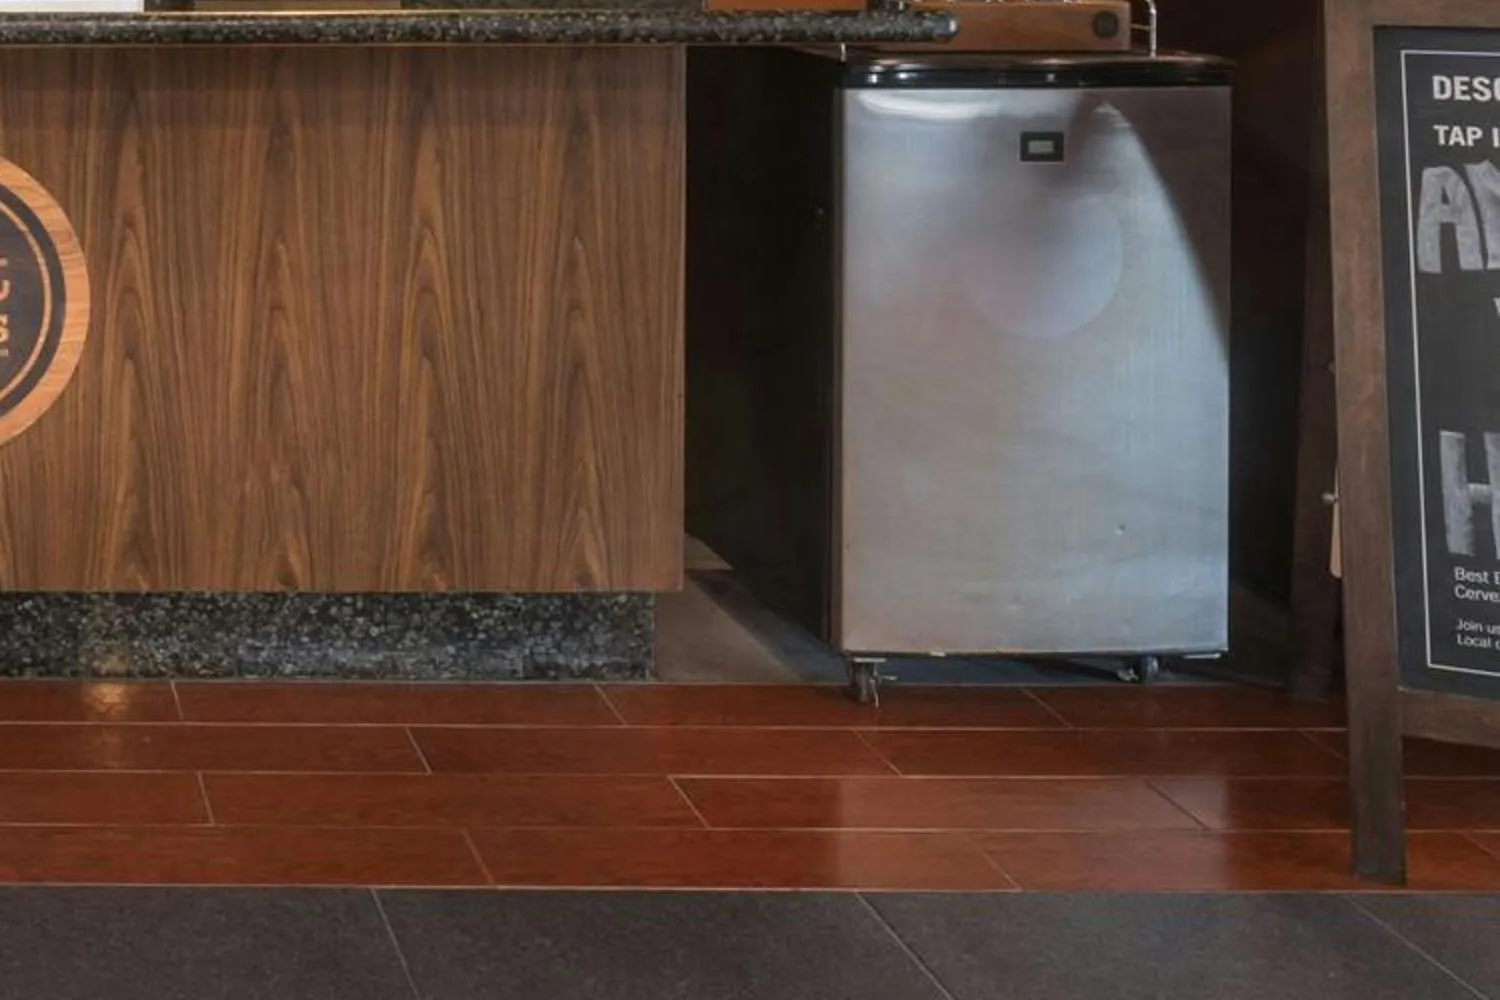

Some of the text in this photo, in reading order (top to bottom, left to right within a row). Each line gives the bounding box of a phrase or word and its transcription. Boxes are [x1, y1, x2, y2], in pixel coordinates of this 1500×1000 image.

[1433, 124, 1483, 147] TAP
[1454, 566, 1489, 585] Best
[1456, 618, 1483, 633] Join
[1456, 632, 1491, 649] Local
